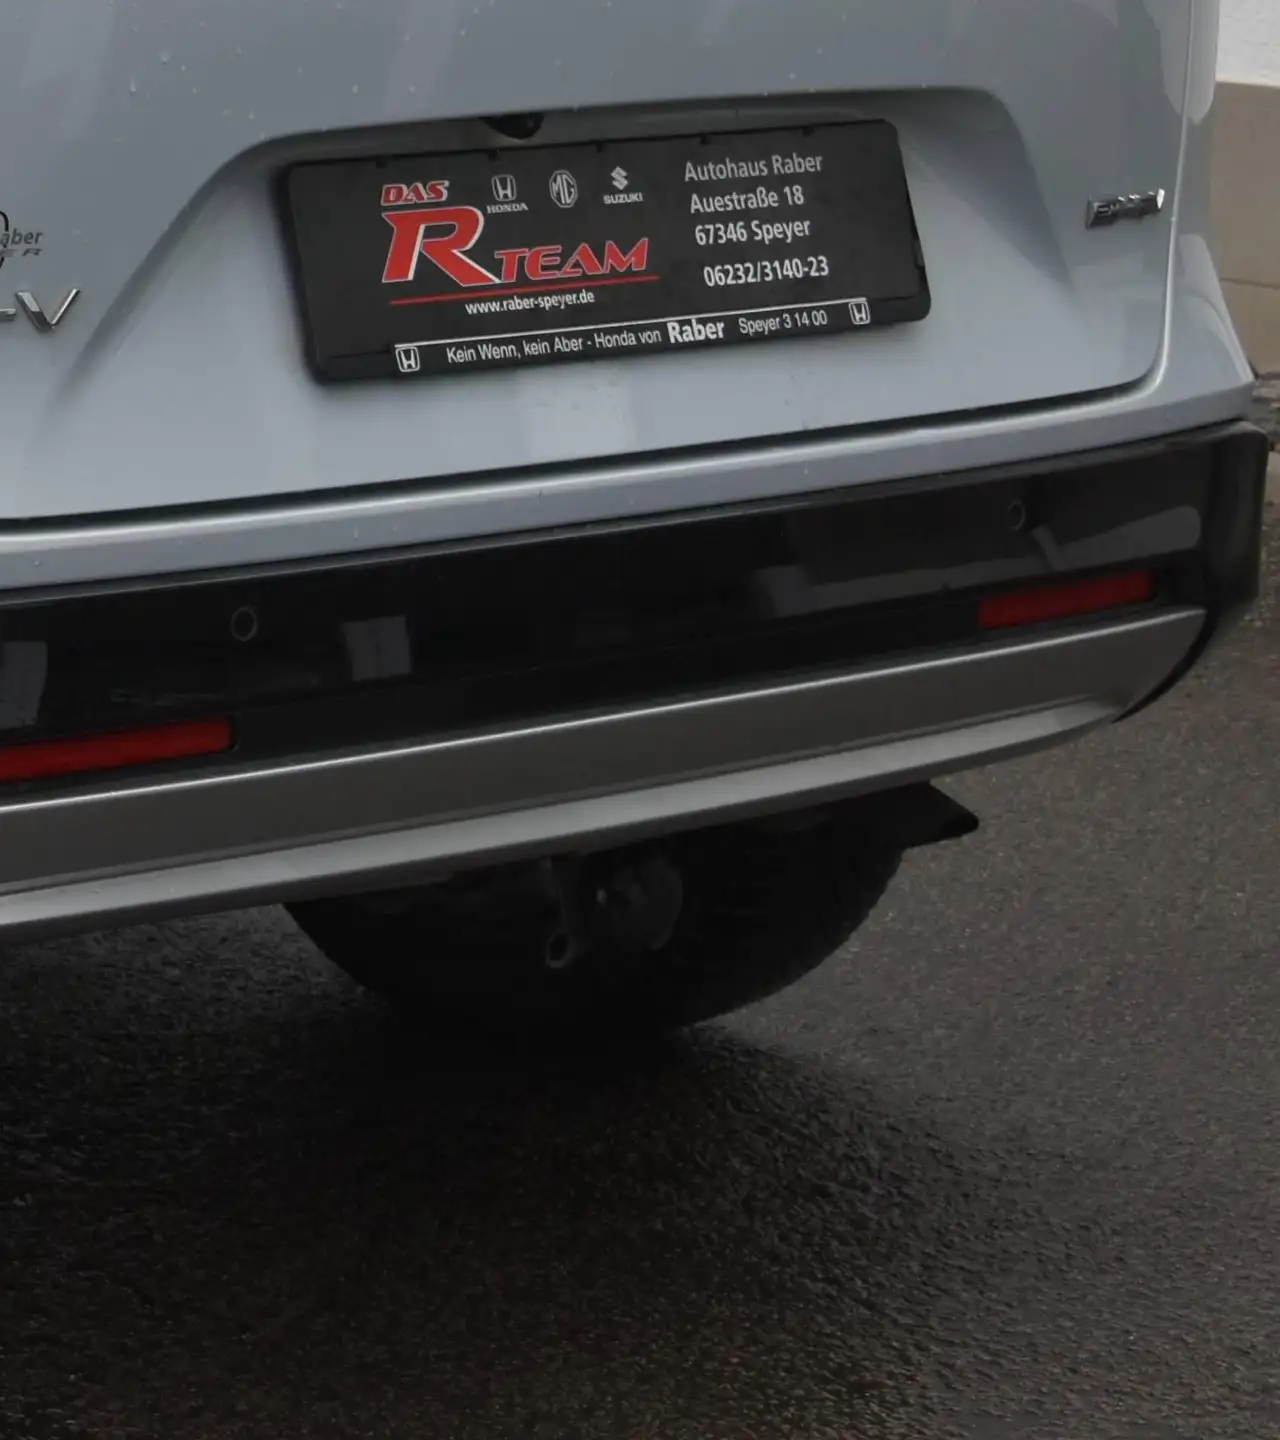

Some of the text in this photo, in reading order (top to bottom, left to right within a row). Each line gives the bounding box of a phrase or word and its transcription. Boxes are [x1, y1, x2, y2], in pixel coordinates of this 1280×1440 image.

[684, 152, 823, 182] Autohaus Raber
[381, 180, 449, 206] DAS
[603, 192, 643, 205] SUZUKI
[690, 184, 805, 214] Auestraße 18
[487, 202, 528, 214] HONDA
[695, 219, 811, 246] 67346 Speyer
[494, 237, 649, 283] TEAM
[703, 255, 830, 287] 06232/3140-23
[465, 289, 595, 315] www.raber-speyer.de
[446, 346, 477, 364] Kein
[477, 340, 522, 360] Wenn,
[523, 338, 551, 356] kein
[553, 335, 583, 352] Aber
[594, 330, 637, 349] Honda
[638, 330, 662, 345] von
[666, 318, 725, 344] Raber
[737, 315, 781, 336] Speyer
[782, 312, 793, 330] 3
[794, 310, 810, 328] 14
[810, 308, 829, 326] 00
